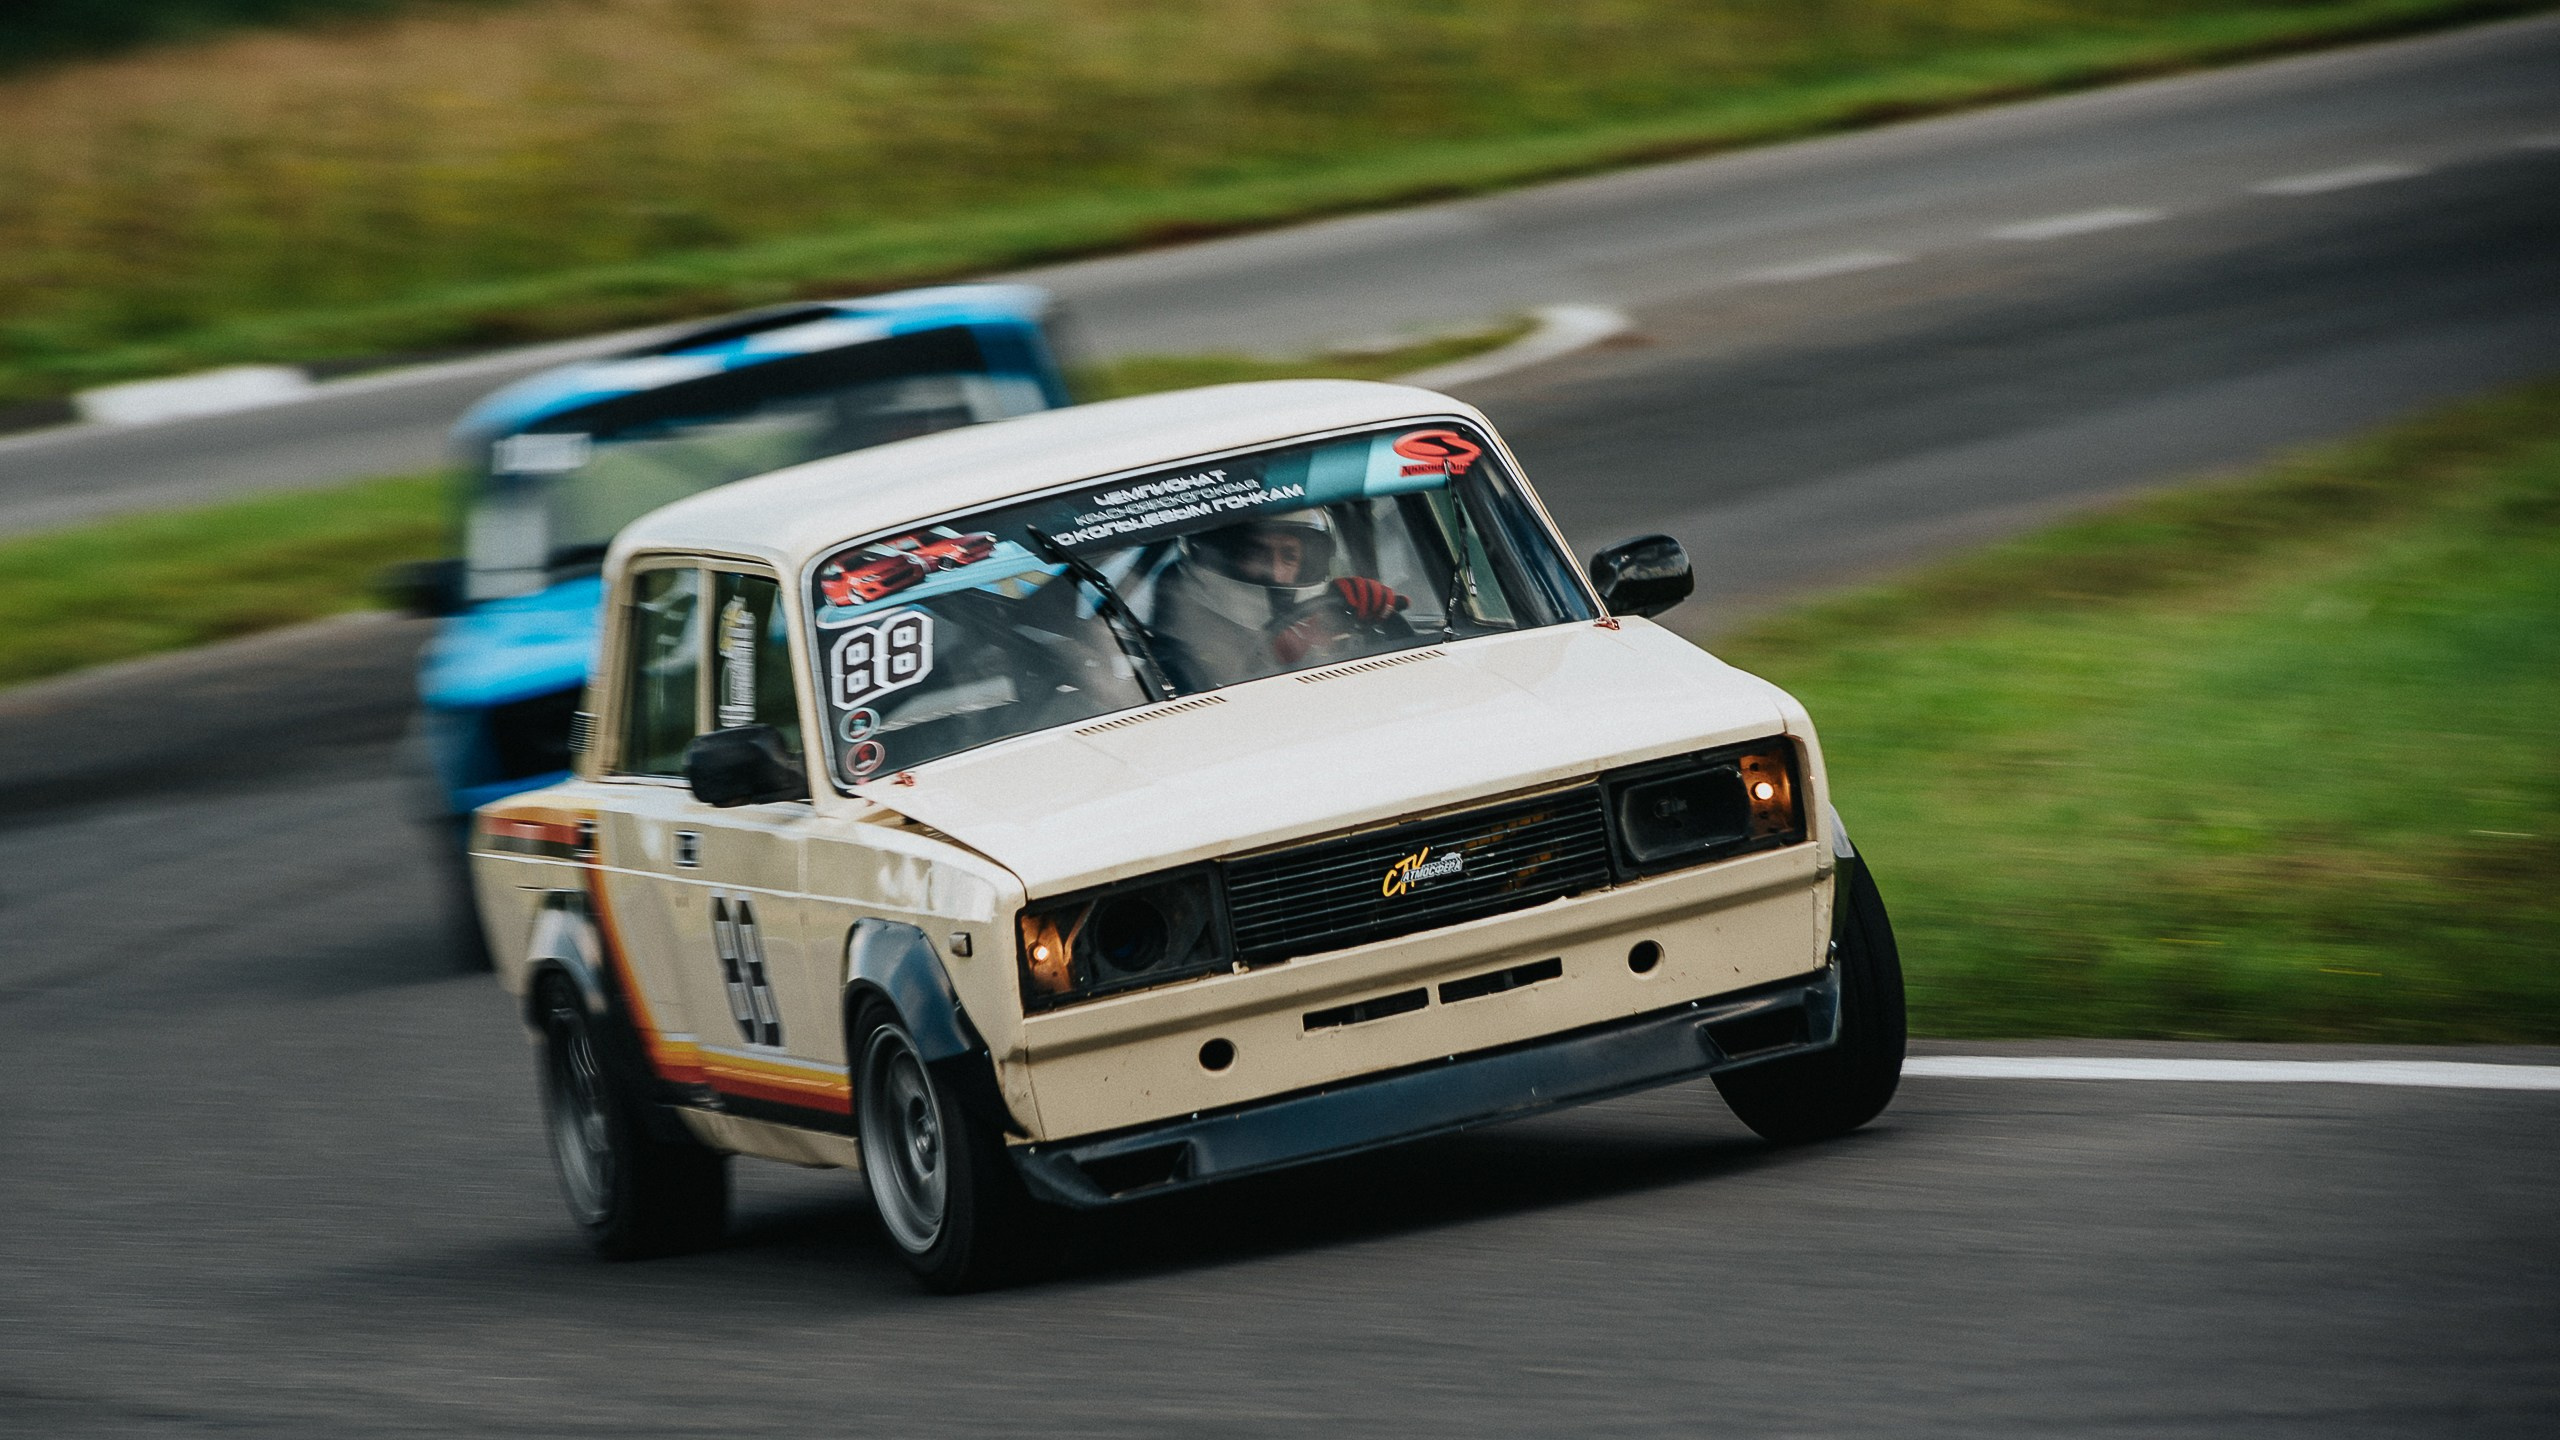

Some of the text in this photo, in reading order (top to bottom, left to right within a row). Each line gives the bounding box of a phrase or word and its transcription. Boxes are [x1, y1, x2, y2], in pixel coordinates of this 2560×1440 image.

[1093, 469, 1227, 506] ЧЕМПИОНАТ
[1074, 502, 1213, 542] КОЛЬЦЕВЫМ
[1212, 482, 1306, 513] ГОНКАМ
[831, 611, 934, 710] 88
[1401, 857, 1463, 884] АТМОСФЕРА
